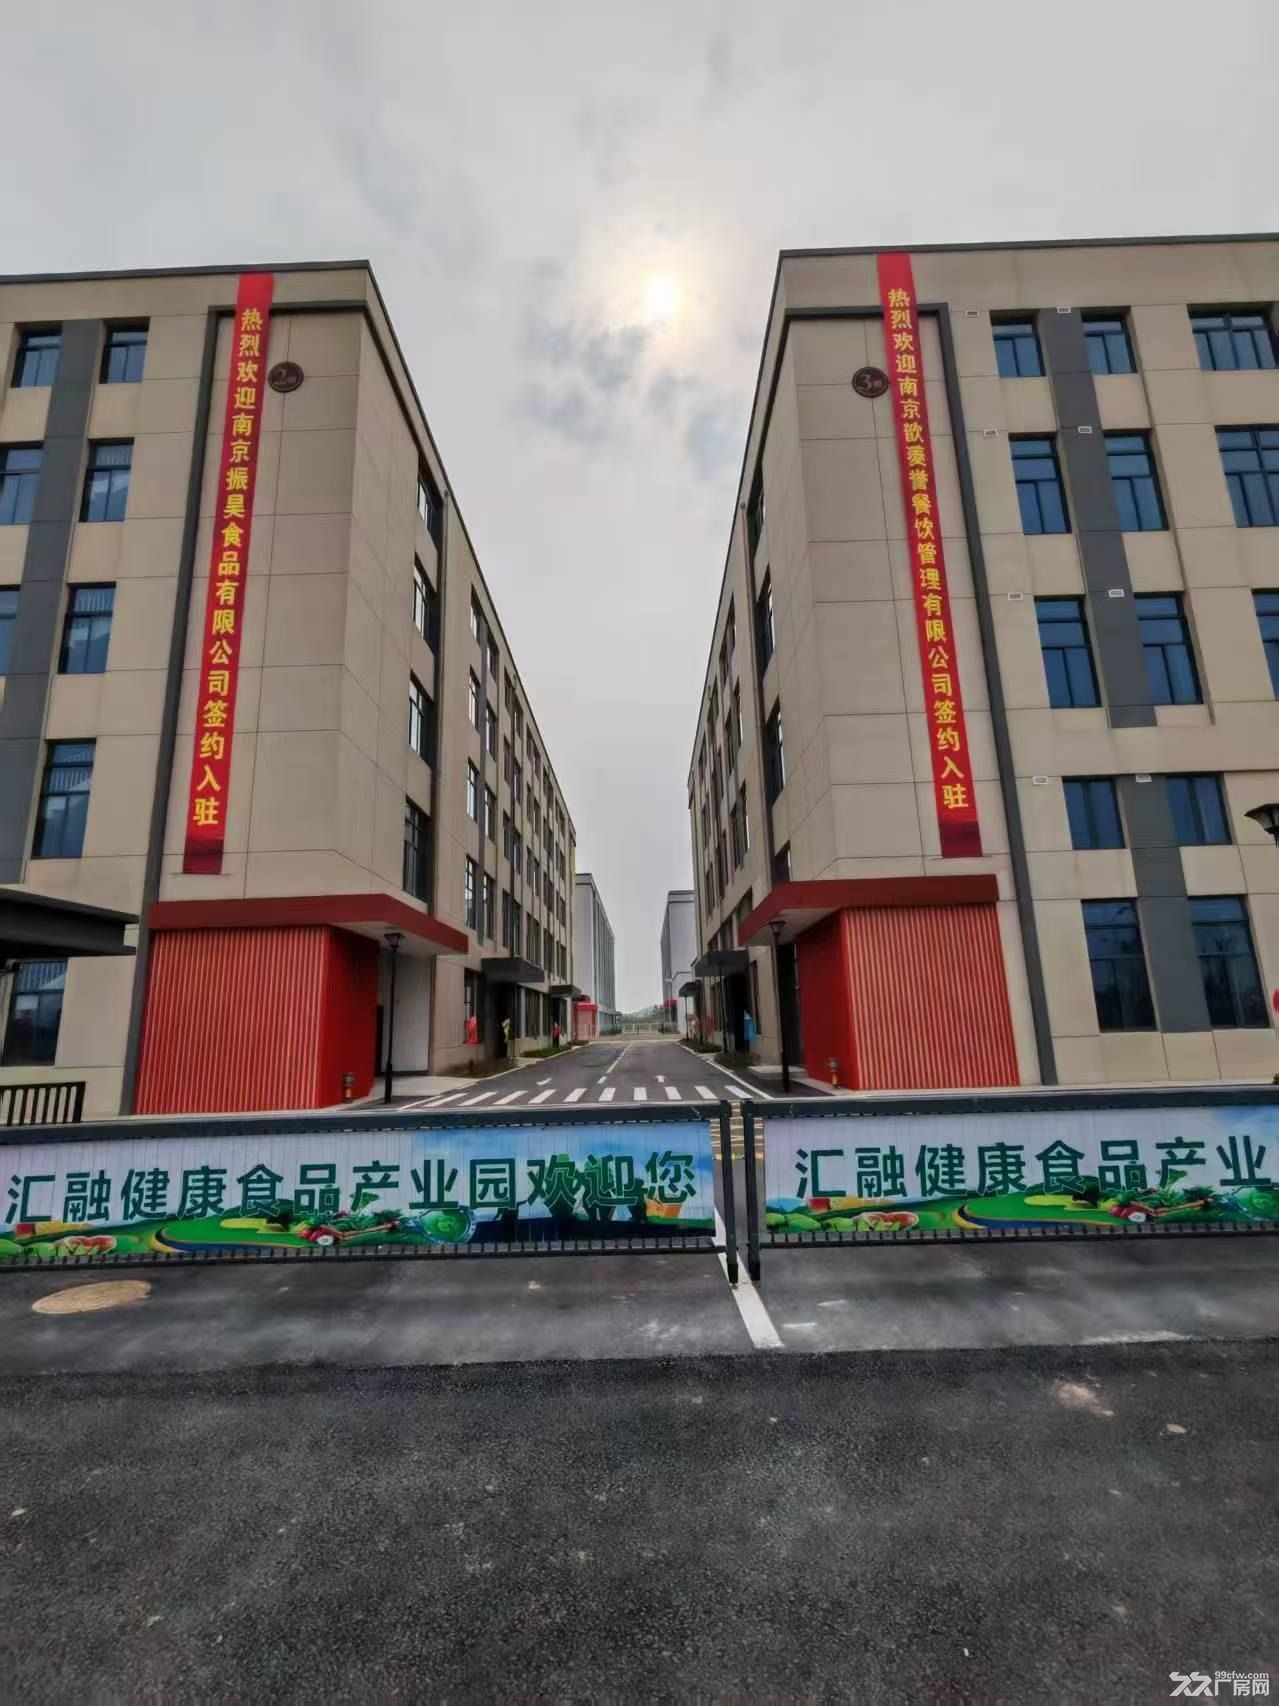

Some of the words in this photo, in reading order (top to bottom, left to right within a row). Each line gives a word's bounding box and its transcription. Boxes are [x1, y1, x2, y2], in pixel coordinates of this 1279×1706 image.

[193, 308, 263, 826] 热烈欢迎南京振昊食品有限公司签约入驻
[5, 1151, 697, 1225] 汇融健康食品产业园欢迎您
